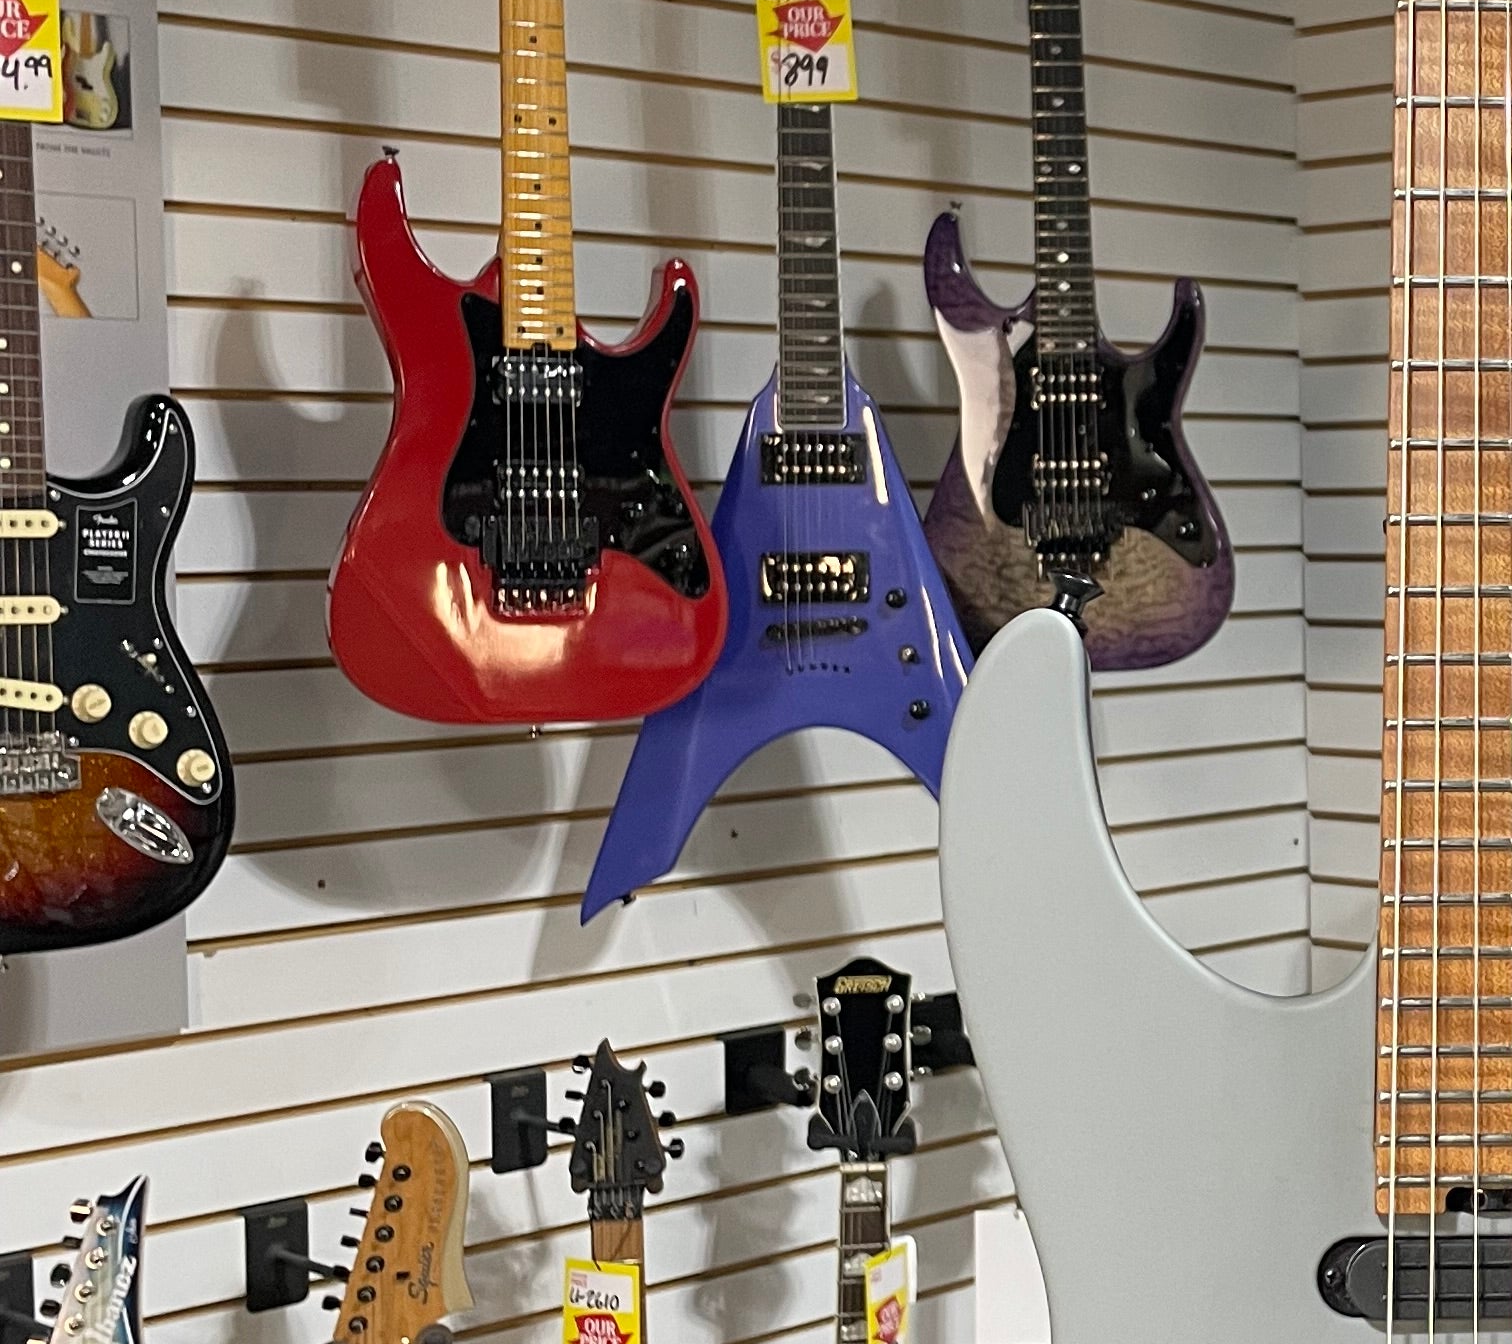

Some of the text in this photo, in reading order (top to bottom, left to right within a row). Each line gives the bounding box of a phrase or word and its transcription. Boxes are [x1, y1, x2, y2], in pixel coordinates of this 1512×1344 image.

[788, 7, 824, 24] OUR
[783, 21, 832, 40] PRICE
[584, 1317, 617, 1337] OUR
